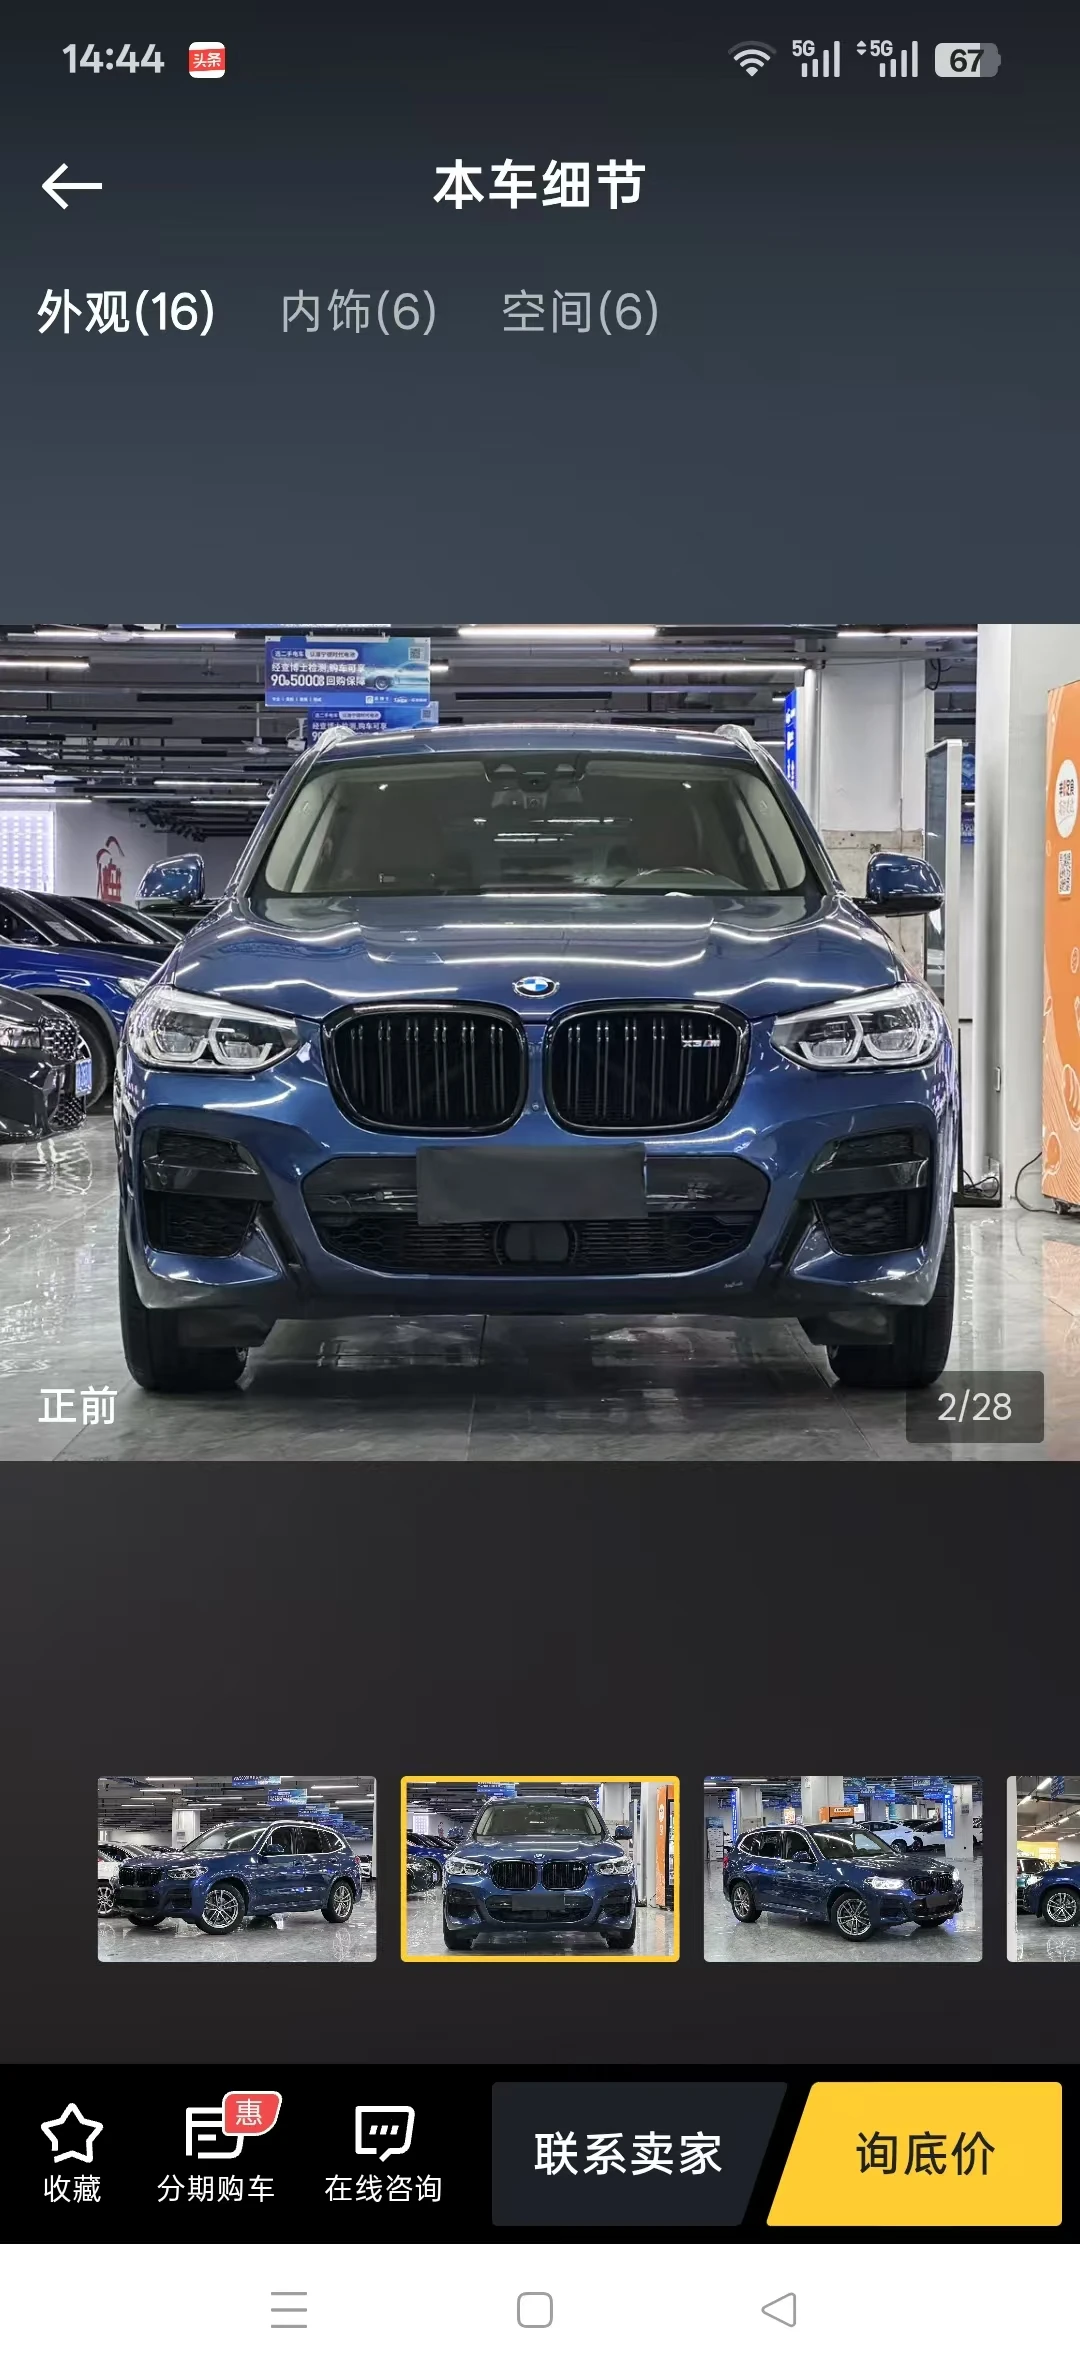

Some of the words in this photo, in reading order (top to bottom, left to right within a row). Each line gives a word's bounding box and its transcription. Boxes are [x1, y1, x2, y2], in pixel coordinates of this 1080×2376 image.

[63, 44, 165, 74] 14:44
[192, 51, 222, 69] 头条
[792, 40, 815, 57] 5G
[870, 40, 893, 57] 5G
[949, 48, 985, 73] 67
[433, 158, 646, 209] 本车细节
[37, 289, 214, 336] 外观(16)
[282, 289, 436, 336] 内饰(6)
[502, 289, 658, 336] 空间(6)
[235, 2097, 263, 2128] 惠
[533, 2130, 723, 2176] 联系卖家
[855, 2130, 996, 2176] 询底价
[43, 2173, 102, 2204] 收藏
[156, 2173, 275, 2204] 分期购车
[324, 2173, 442, 2204] 在线咨询
